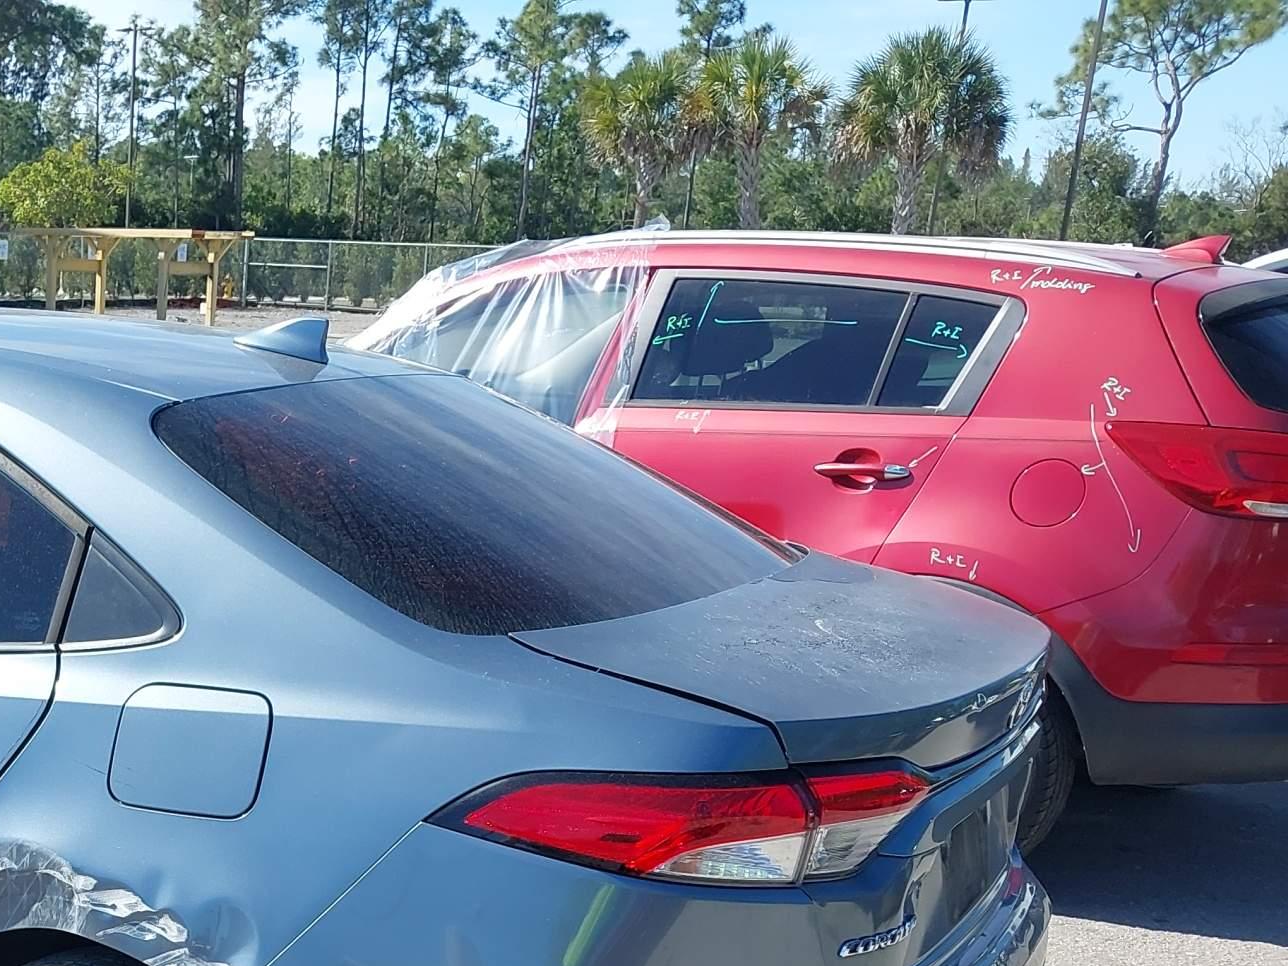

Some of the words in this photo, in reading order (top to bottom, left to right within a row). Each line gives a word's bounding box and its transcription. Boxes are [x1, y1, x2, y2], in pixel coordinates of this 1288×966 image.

[1029, 278, 1096, 294] molding
[931, 321, 963, 340] R+I
[1100, 376, 1132, 401] R+I
